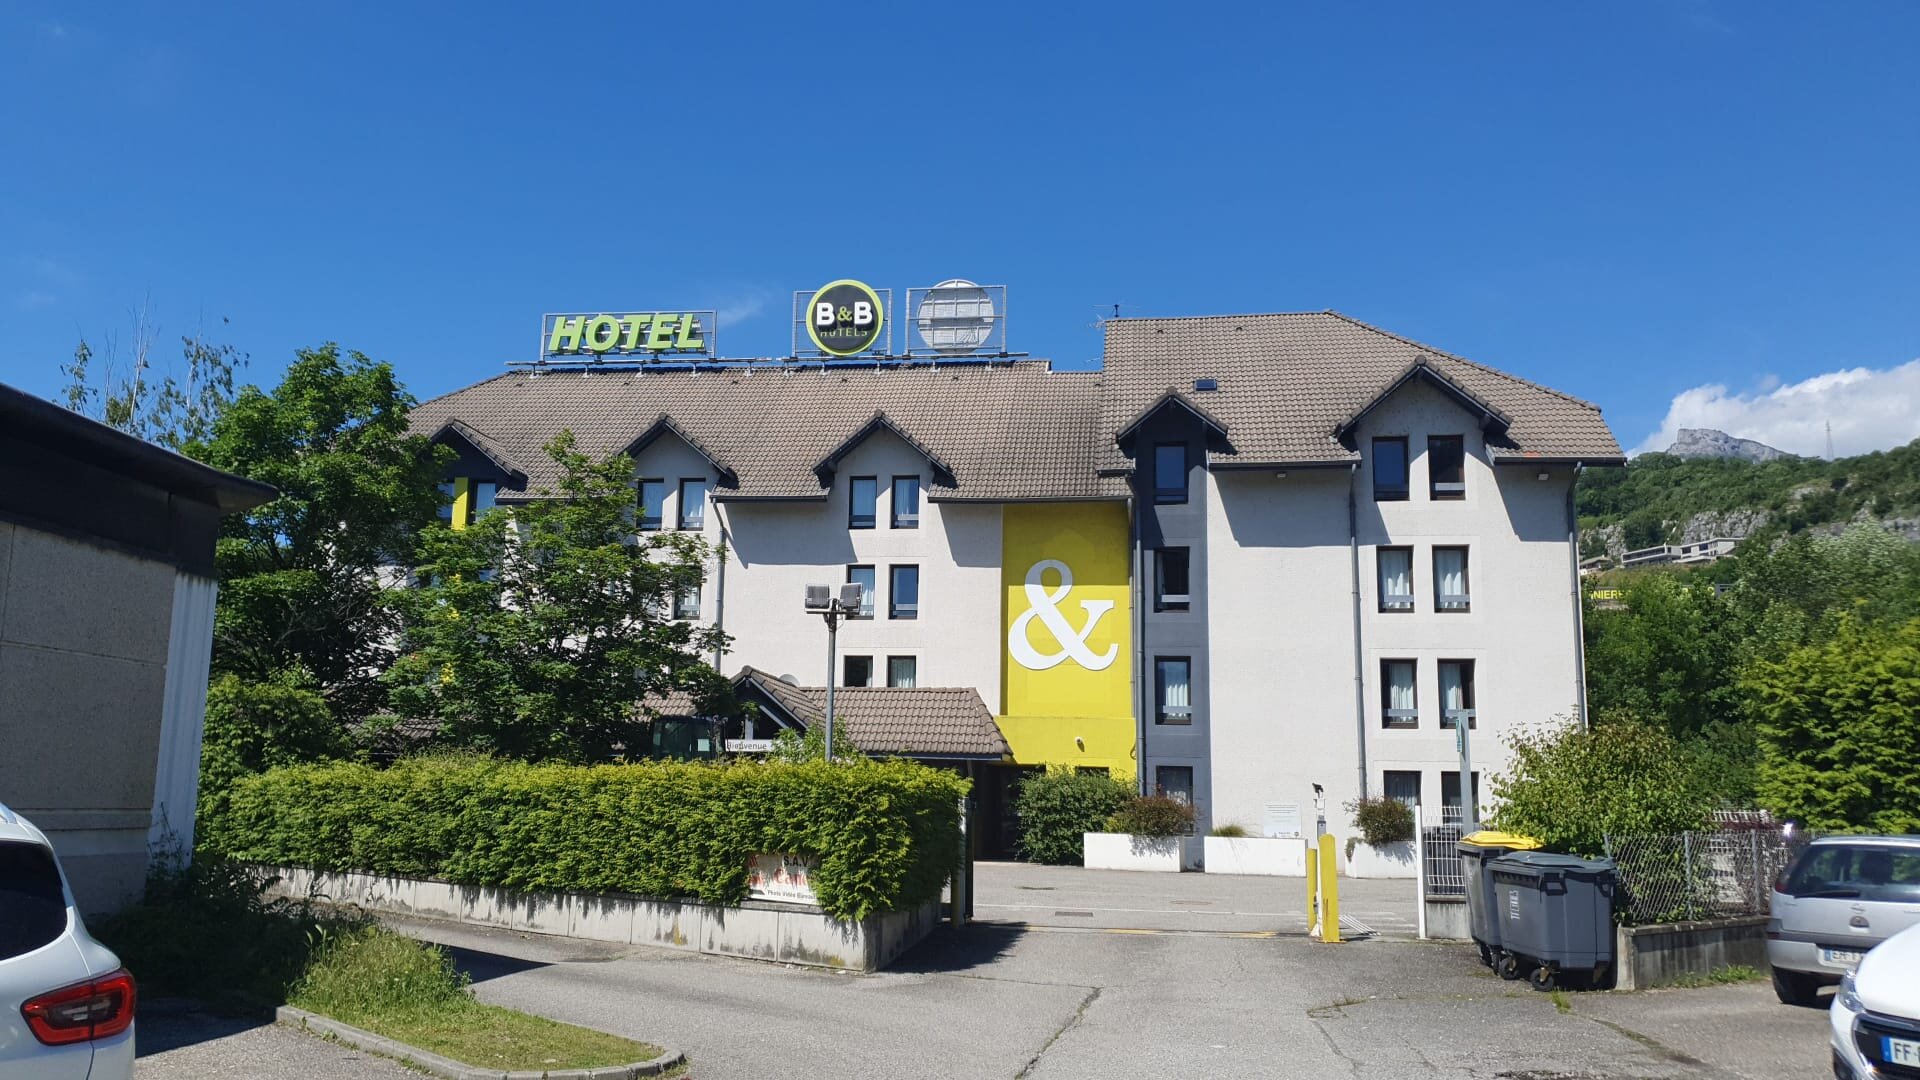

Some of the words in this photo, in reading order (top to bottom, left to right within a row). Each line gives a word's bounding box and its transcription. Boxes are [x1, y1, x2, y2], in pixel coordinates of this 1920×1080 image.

[816, 301, 873, 326] B&B
[548, 313, 705, 352] HOTEL
[820, 327, 868, 337] HOTELS
[1008, 559, 1119, 671] &
